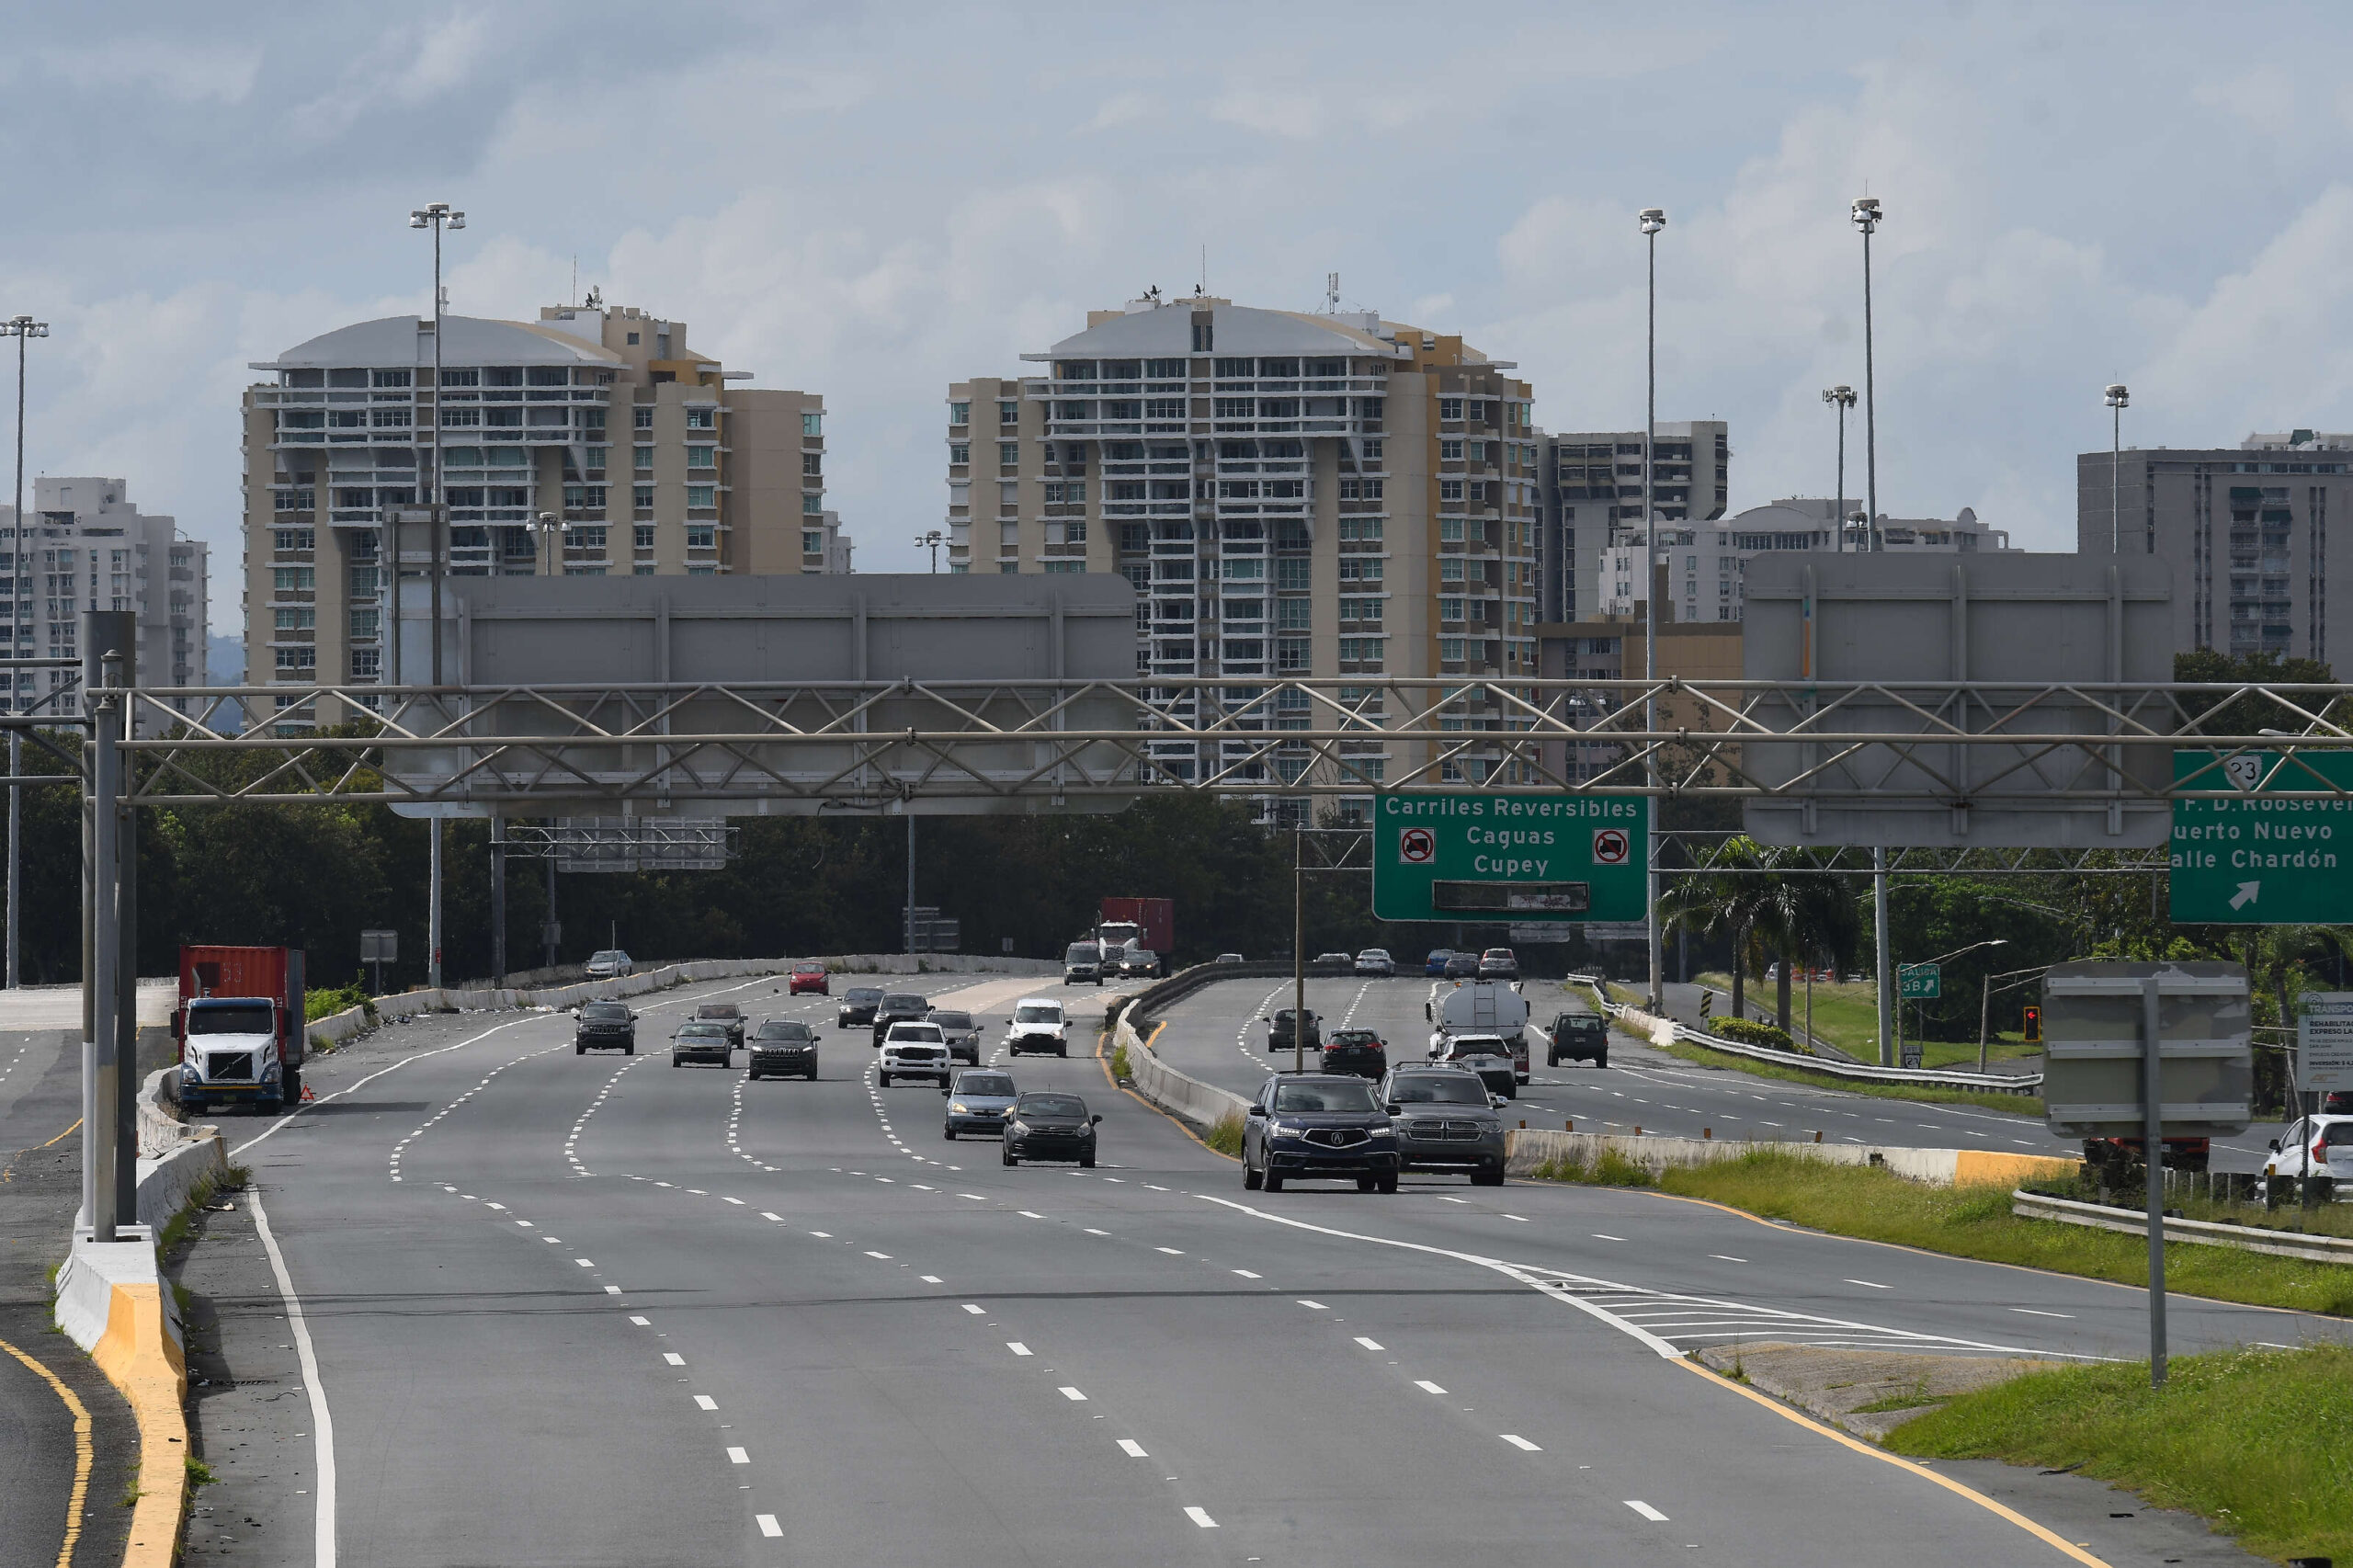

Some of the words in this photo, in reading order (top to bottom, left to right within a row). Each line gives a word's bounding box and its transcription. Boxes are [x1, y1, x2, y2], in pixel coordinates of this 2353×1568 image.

[2231, 761, 2256, 780] 23
[1385, 797, 1483, 816] Carriles
[1495, 798, 1638, 818] Reversibles
[1466, 826, 1555, 850] Caguas
[2174, 822, 2241, 840] uerto
[2254, 822, 2333, 840] Nuevo
[1474, 855, 1549, 877] Cupey
[2171, 849, 2217, 869] alle
[2232, 848, 2337, 869] Chardón
[1903, 981, 1921, 992] 3B
